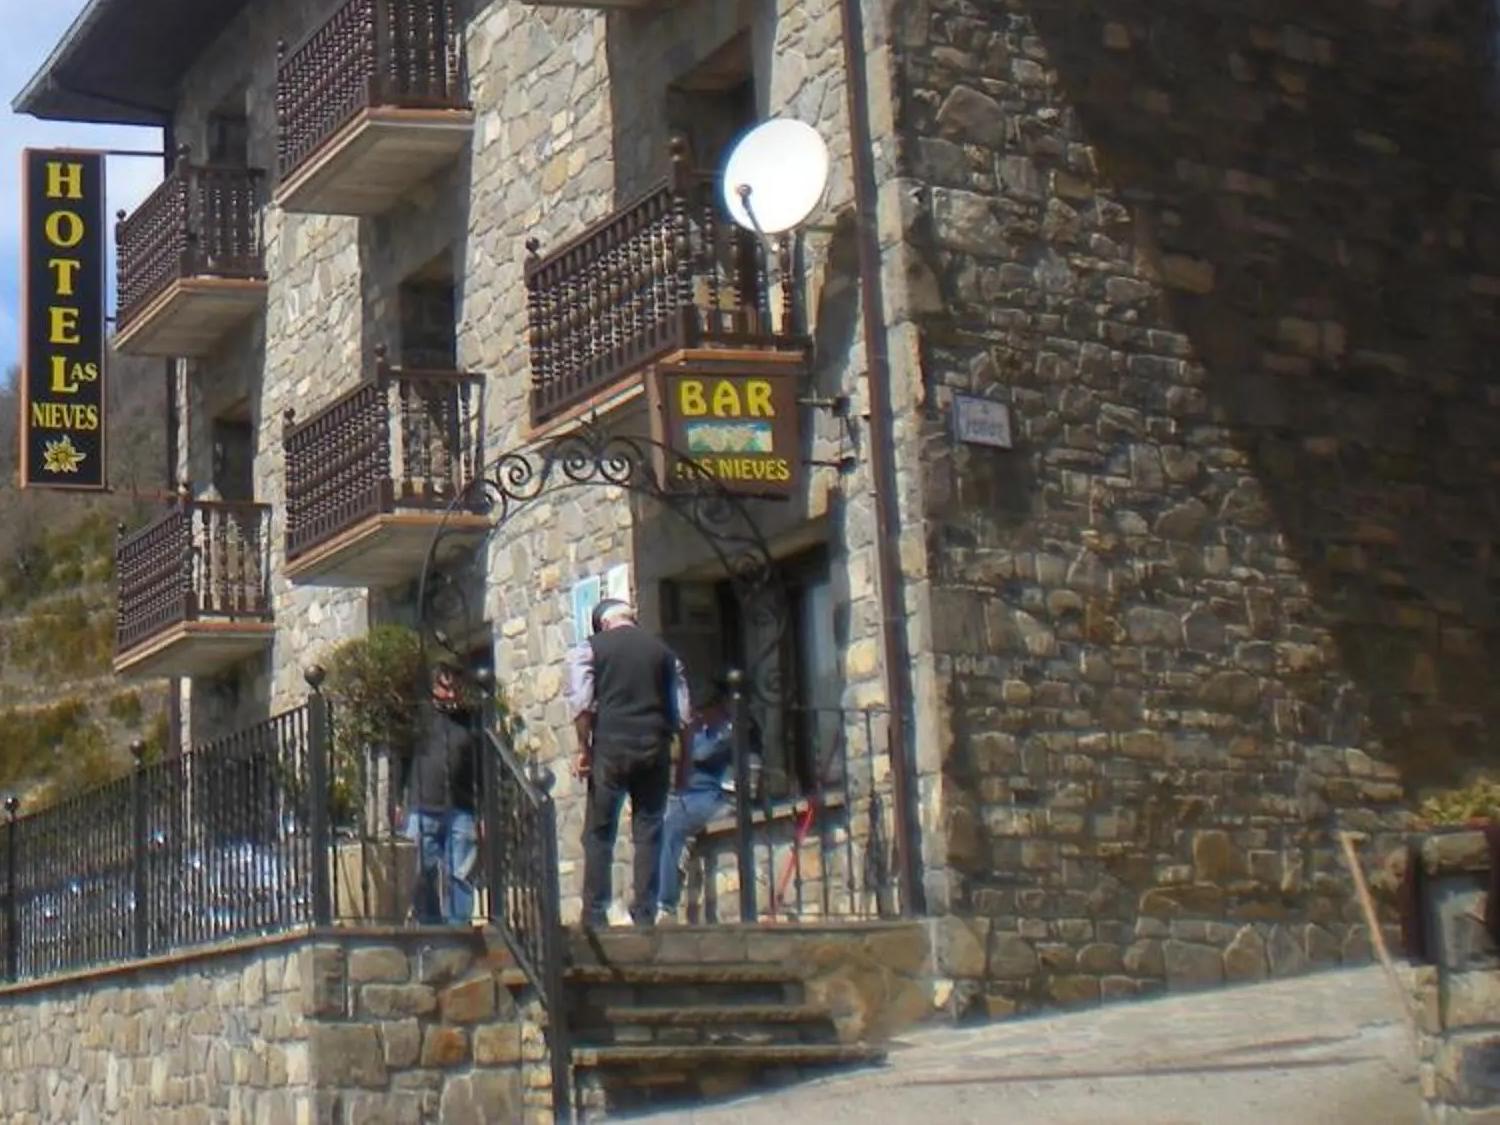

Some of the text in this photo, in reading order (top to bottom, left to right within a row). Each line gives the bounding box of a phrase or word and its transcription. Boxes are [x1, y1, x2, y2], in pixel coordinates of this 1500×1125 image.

[45, 162, 85, 393] HOTEL
[680, 380, 775, 417] BAR
[32, 403, 98, 430] NIEVES
[719, 458, 790, 480] NIEVES
